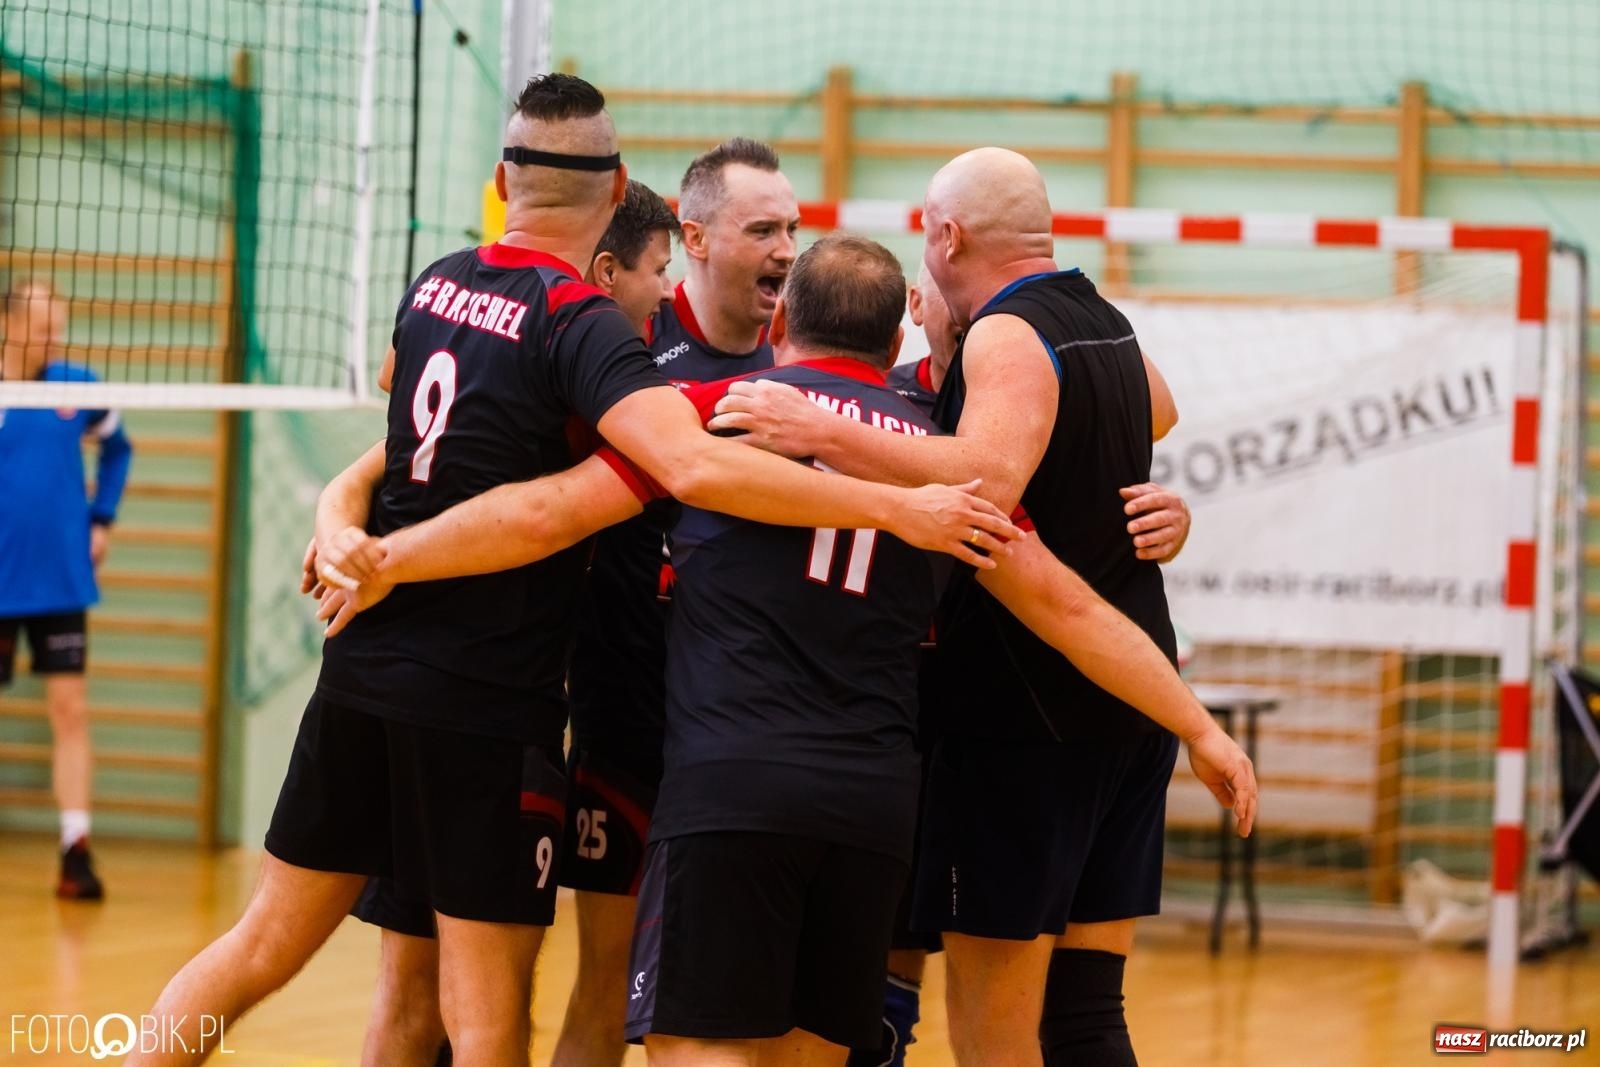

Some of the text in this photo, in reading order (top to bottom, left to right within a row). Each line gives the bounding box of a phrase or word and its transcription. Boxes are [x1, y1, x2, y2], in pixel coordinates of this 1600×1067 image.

[411, 350, 457, 483] 9
[577, 808, 607, 860] 25
[536, 836, 553, 888] 9
